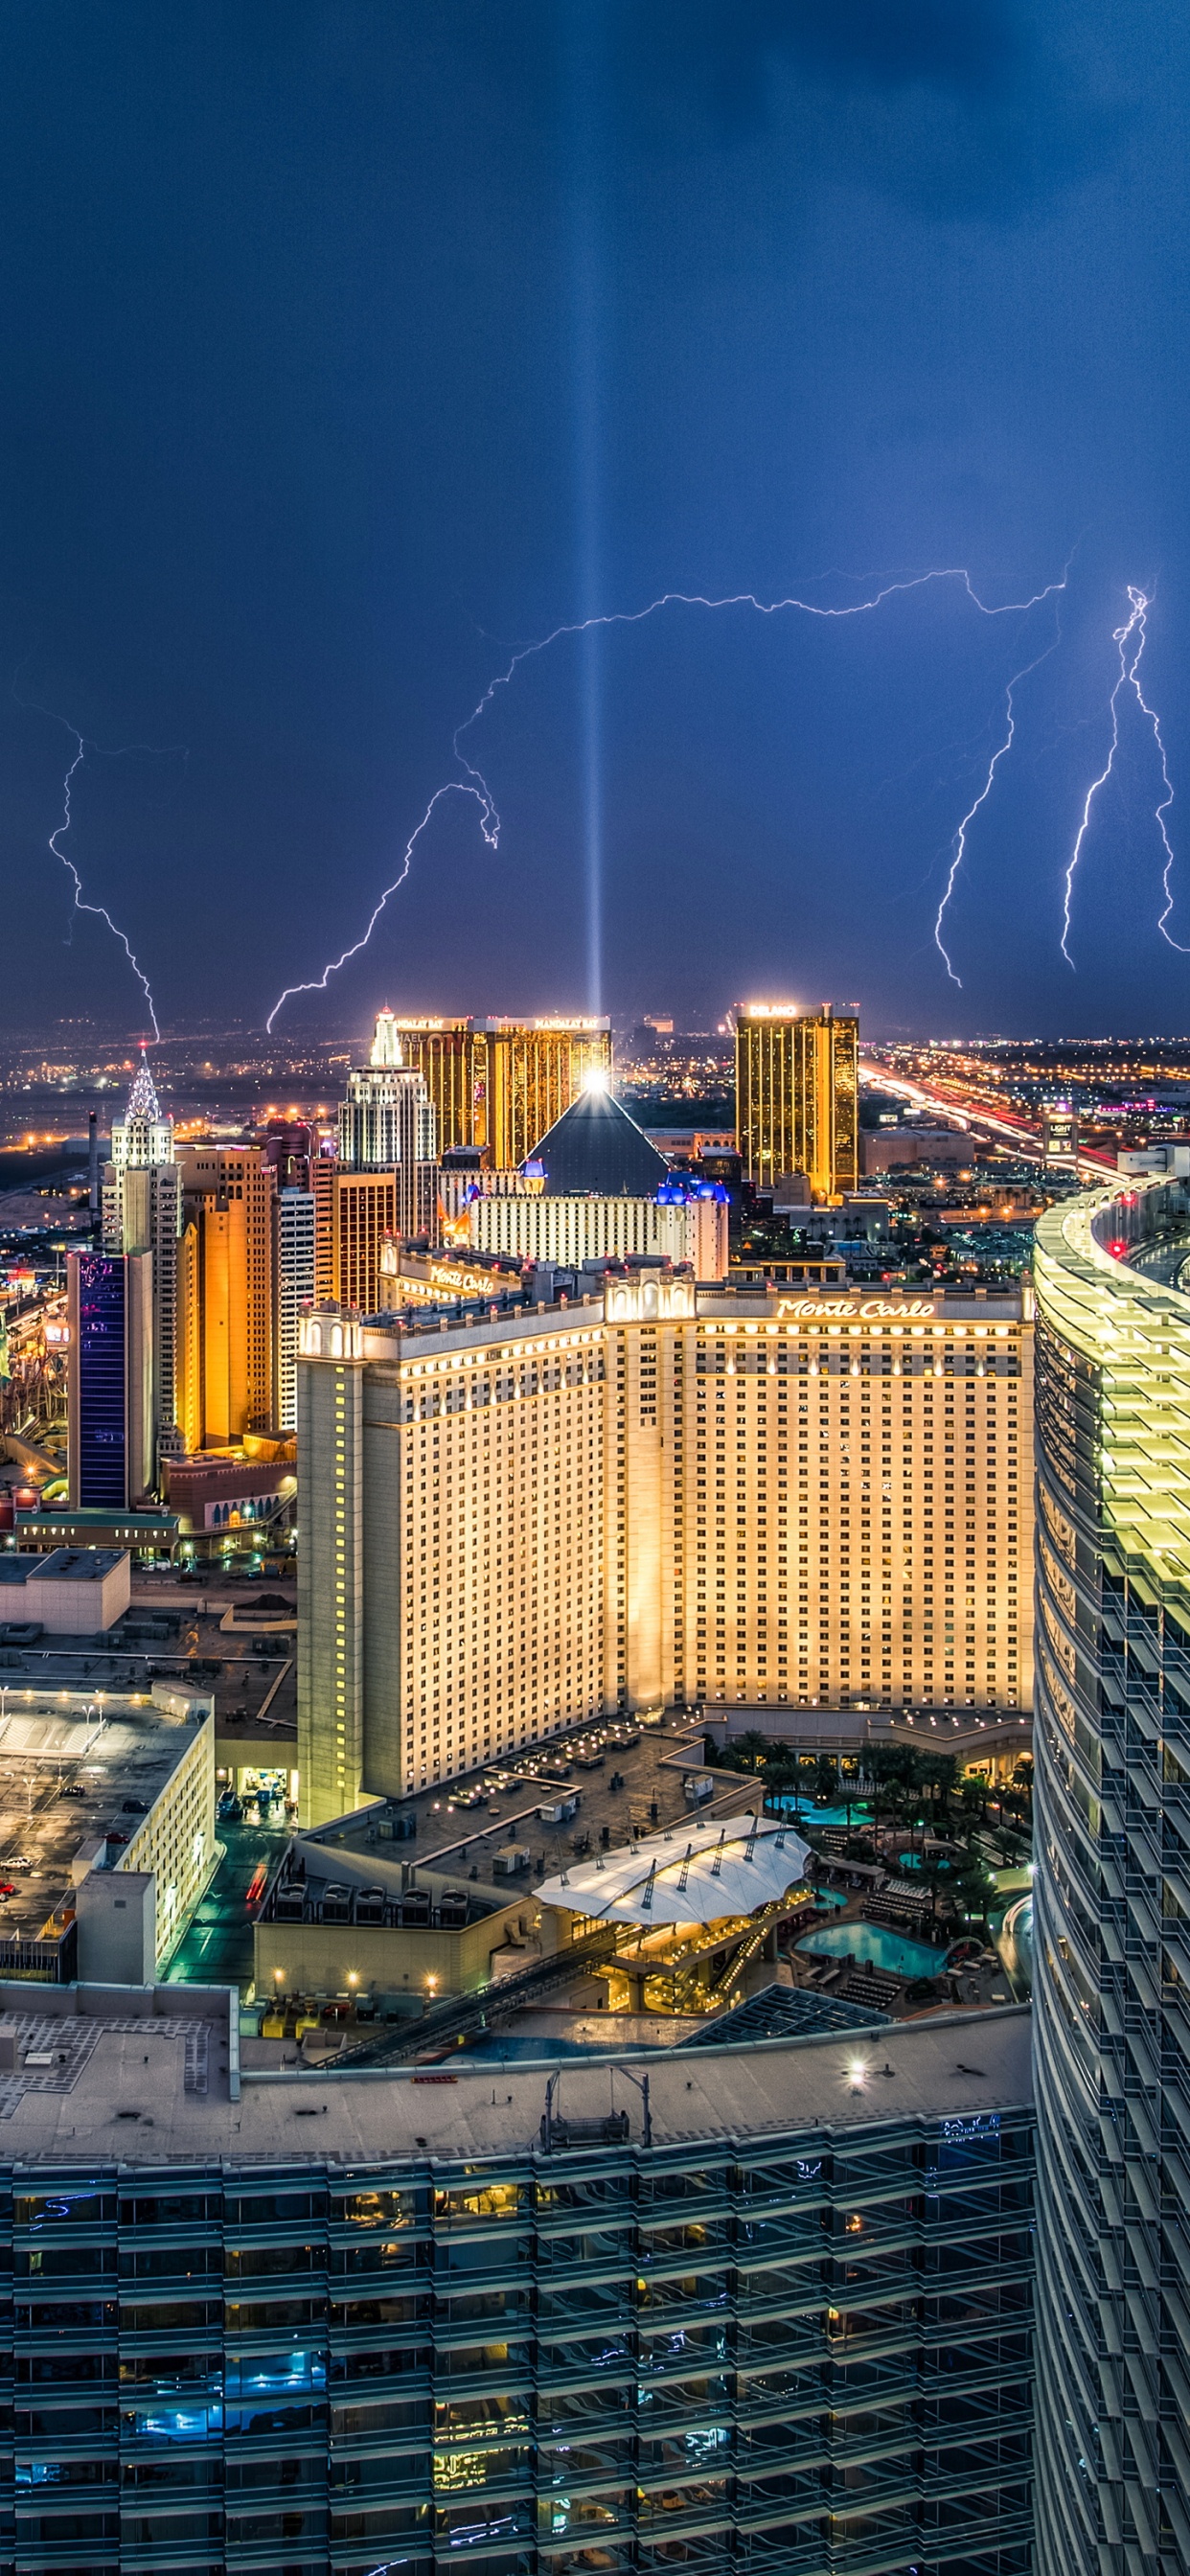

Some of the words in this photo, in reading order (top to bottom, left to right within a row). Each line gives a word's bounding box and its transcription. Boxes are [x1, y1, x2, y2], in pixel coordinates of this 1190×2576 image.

[749, 1005, 796, 1017] DELANO
[394, 1020, 427, 1029] ANDALAY
[428, 1020, 444, 1029] BAY
[535, 1019, 582, 1029] MANDALAY
[582, 1020, 599, 1029] BAY
[430, 1265, 463, 1287] Monte
[463, 1274, 494, 1294] Carlo
[776, 1300, 858, 1319] Monte
[859, 1300, 935, 1319] Carlo
